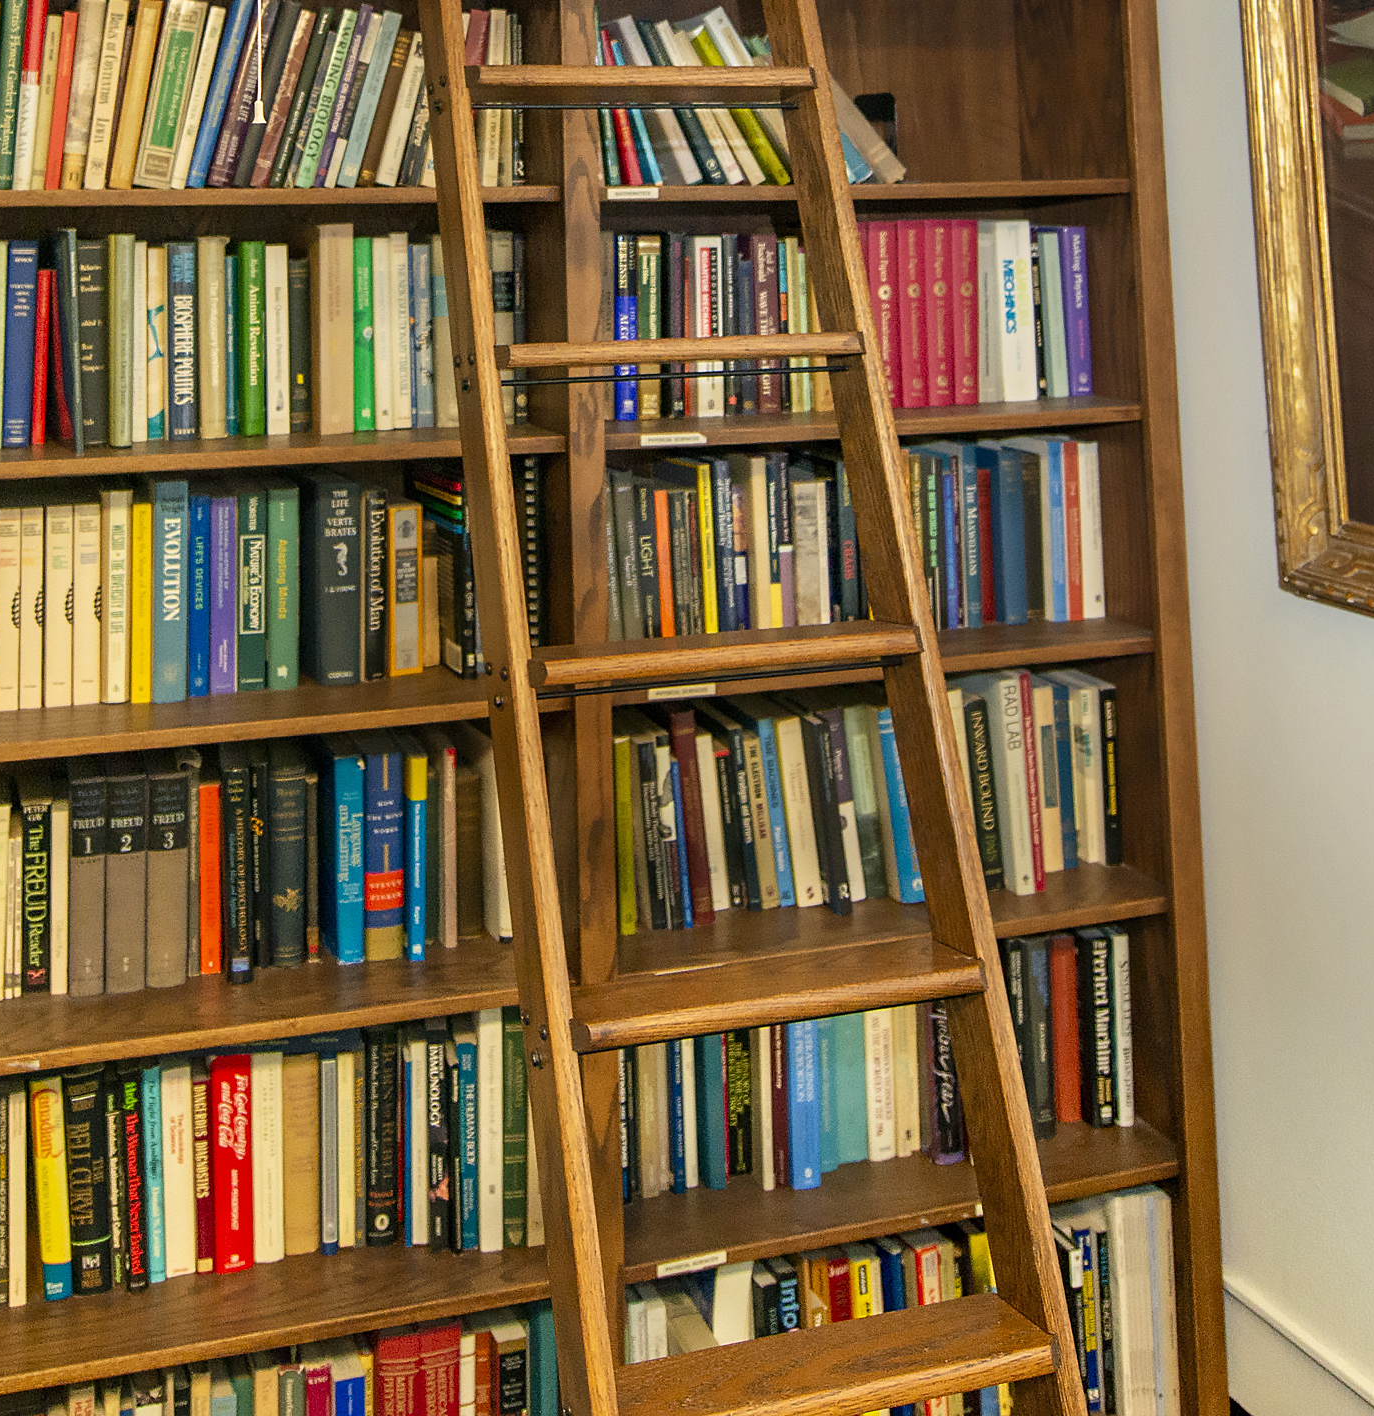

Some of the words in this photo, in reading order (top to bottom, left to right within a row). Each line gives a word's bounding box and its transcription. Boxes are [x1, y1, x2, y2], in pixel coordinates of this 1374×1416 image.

[7, 37, 20, 68] Flower
[322, 28, 351, 90] WRITING
[5, 71, 16, 105] Garden
[0, 108, 14, 154] Displayed
[306, 95, 333, 161] BIOLOGY
[1072, 235, 1083, 269] Making
[250, 284, 259, 323] Animal
[1004, 260, 1016, 333] MECHANICS
[1072, 273, 1084, 309] Physics
[173, 296, 192, 355] BIOSPHERE
[250, 327, 259, 386] Revolution
[175, 359, 192, 405] POLITICS
[331, 500, 350, 508] LIFE
[966, 484, 977, 504] THE
[112, 525, 123, 550] WILSON
[194, 536, 203, 565] LIFE'S
[324, 529, 357, 537] BRATES
[370, 511, 383, 572] Evolution
[967, 508, 978, 576] MAXWELLIANS
[112, 560, 124, 571] THE
[163, 518, 179, 621] EVOLUTION
[247, 541, 261, 582] NATURE'S
[275, 540, 288, 583] Adapting
[640, 536, 653, 577] LIGHT
[111, 574, 124, 608] DIVERSITY
[194, 568, 203, 610] DEVICES
[277, 587, 288, 619] Minds
[370, 577, 382, 593] of
[111, 620, 123, 634] LIFE
[247, 586, 260, 629] ECONOMY
[370, 596, 382, 630] Man
[1004, 686, 1017, 714] RAD
[971, 710, 988, 767] INWARD
[1007, 721, 1020, 751] LAB
[978, 772, 994, 829] BOUND
[28, 826, 44, 850] The
[25, 852, 47, 920] FREUD
[29, 924, 45, 966] Reader
[1094, 949, 1108, 1005] Perfect
[1096, 1008, 1110, 1075] Machine
[124, 1083, 137, 1110] Hrdy
[430, 1045, 441, 1128] IMMUNOLOGY
[127, 1114, 139, 1131] The
[196, 1085, 207, 1137] DANGEROUS
[68, 1123, 91, 1163] BELL
[127, 1134, 141, 1180] Woman
[197, 1141, 210, 1198] DIAGNOSTICS
[70, 1168, 94, 1226] CURVE
[128, 1181, 140, 1200] That
[128, 1201, 141, 1234] Never
[131, 1236, 144, 1275] Evolved
